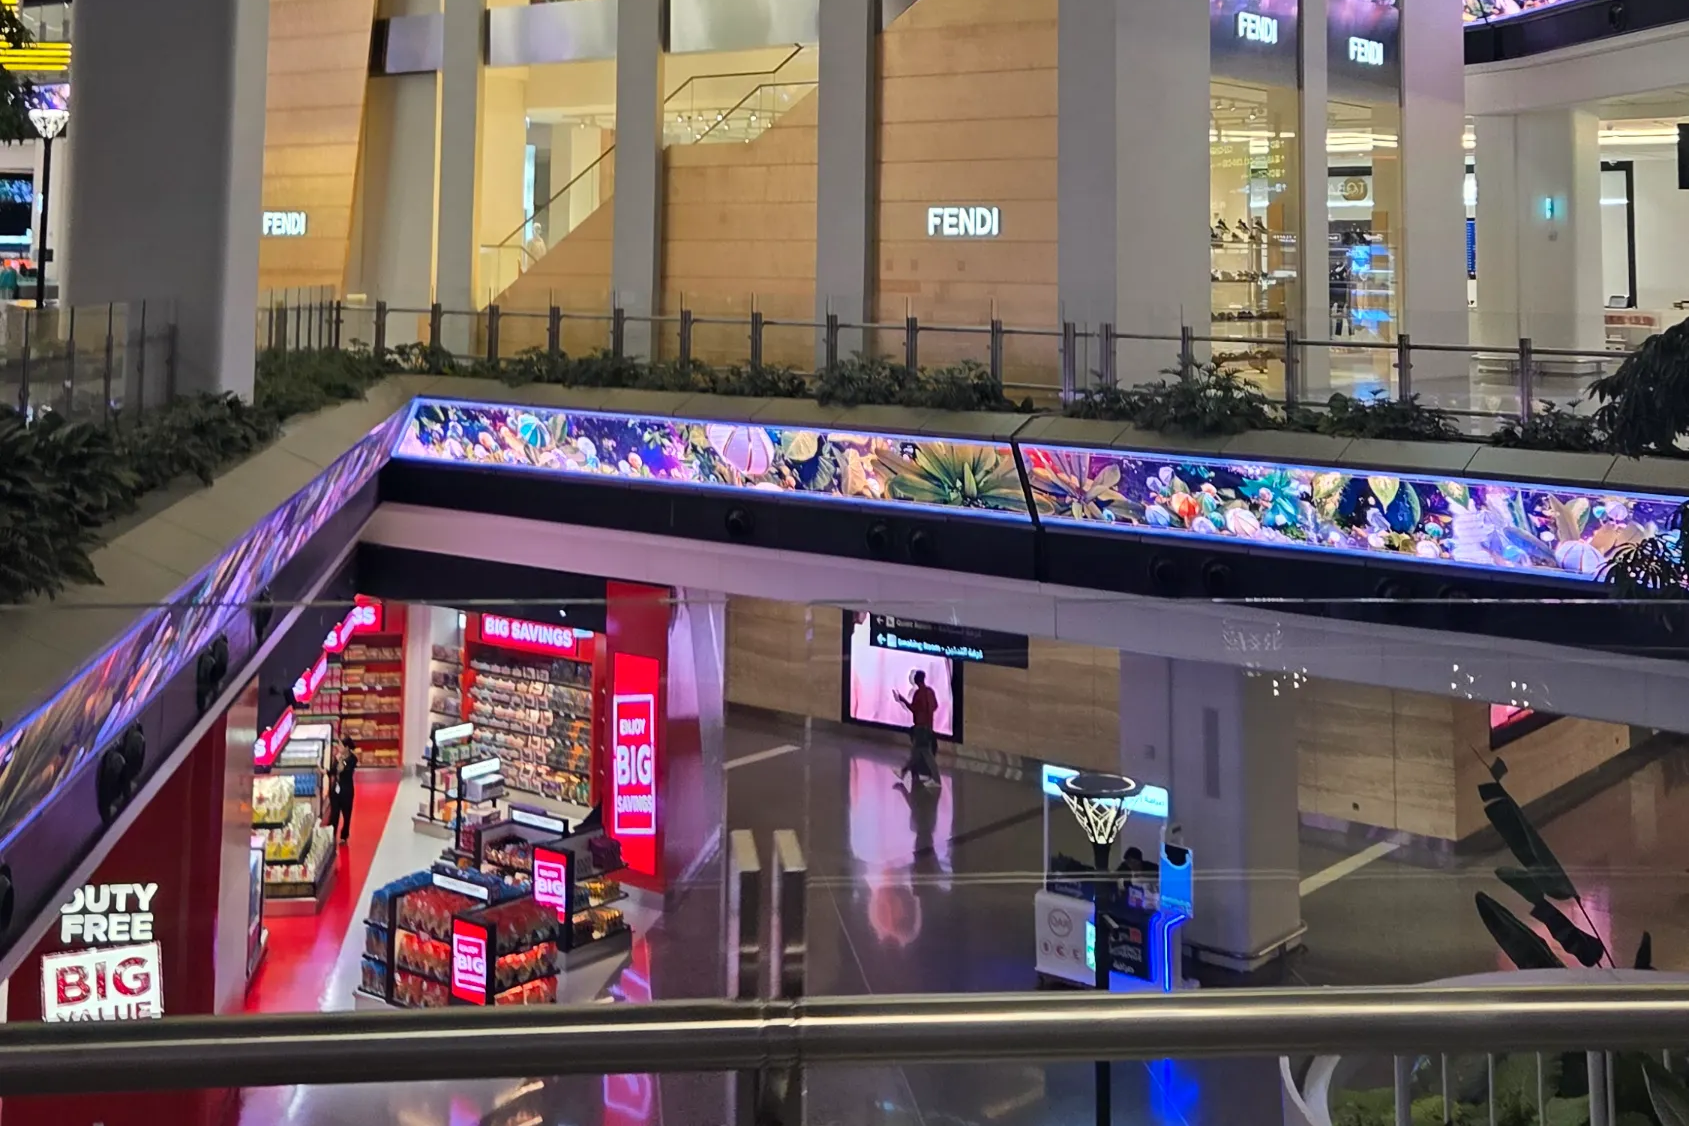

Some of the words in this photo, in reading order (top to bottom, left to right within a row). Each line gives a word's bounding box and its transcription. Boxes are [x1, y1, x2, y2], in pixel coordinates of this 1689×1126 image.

[1238, 11, 1278, 44] FENDI
[1349, 36, 1384, 65] FENDI
[263, 211, 307, 235] FENDI
[928, 206, 999, 236] FENDI
[485, 617, 509, 638] BIG
[511, 622, 573, 648] SAVINGS
[619, 717, 646, 735] ENJOY
[616, 744, 652, 785] BIG
[617, 794, 653, 814] SAVINGS
[538, 877, 564, 896] BIG
[61, 912, 153, 943] FREE
[457, 954, 484, 975] BIG
[56, 957, 152, 1007] BIG
